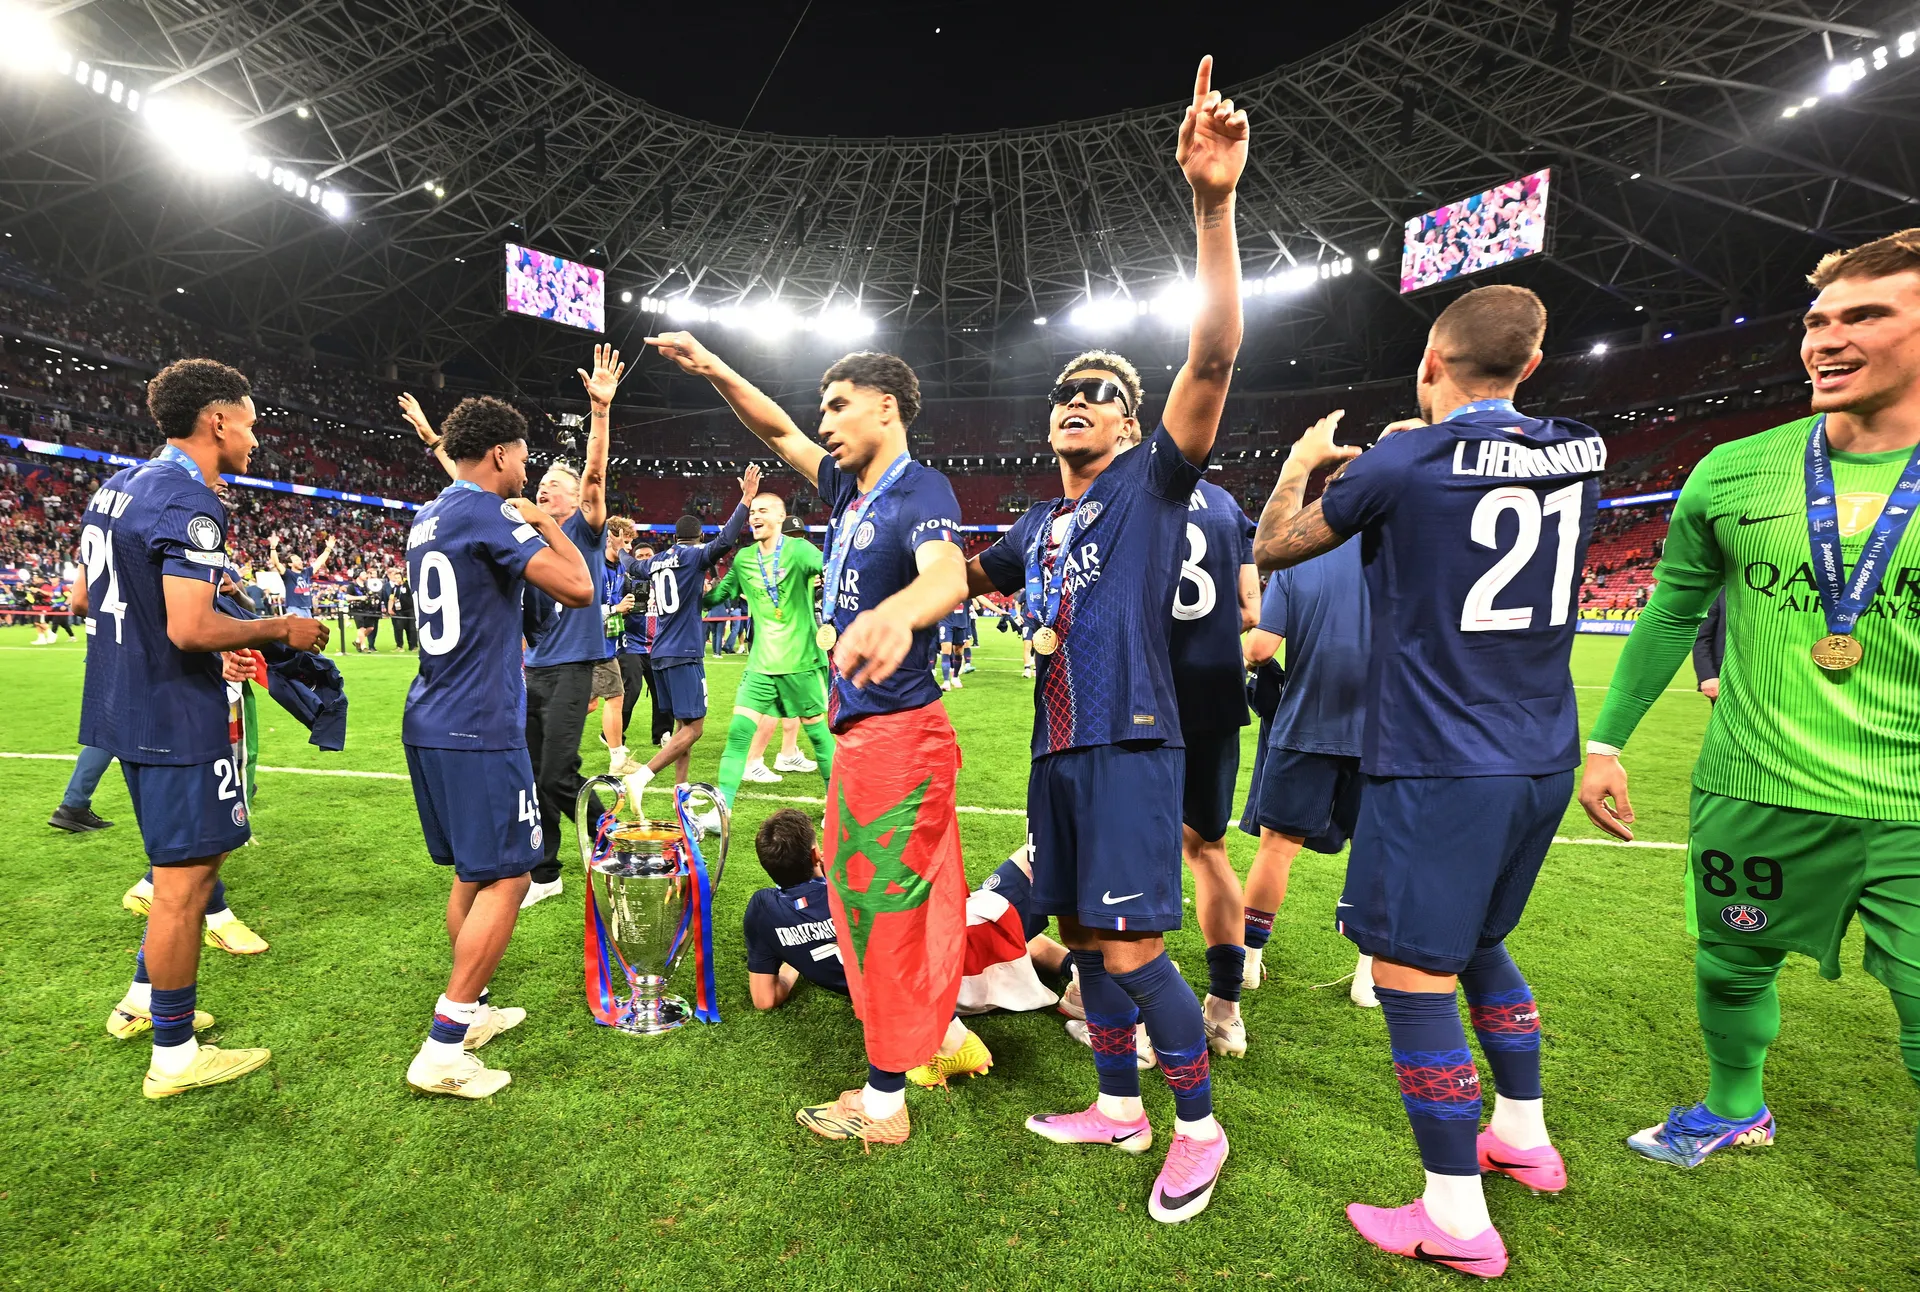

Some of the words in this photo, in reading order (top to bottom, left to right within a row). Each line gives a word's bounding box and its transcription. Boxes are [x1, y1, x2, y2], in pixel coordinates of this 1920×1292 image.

[1460, 481, 1584, 631] 21
[1869, 529, 1891, 558] FINAL
[81, 524, 128, 645] 24
[652, 568, 680, 615] 10
[1744, 561, 1920, 598] QAR
[1829, 583, 1840, 609] FINA
[1779, 595, 1920, 620] AIRAYS
[1701, 849, 1783, 900] 89
